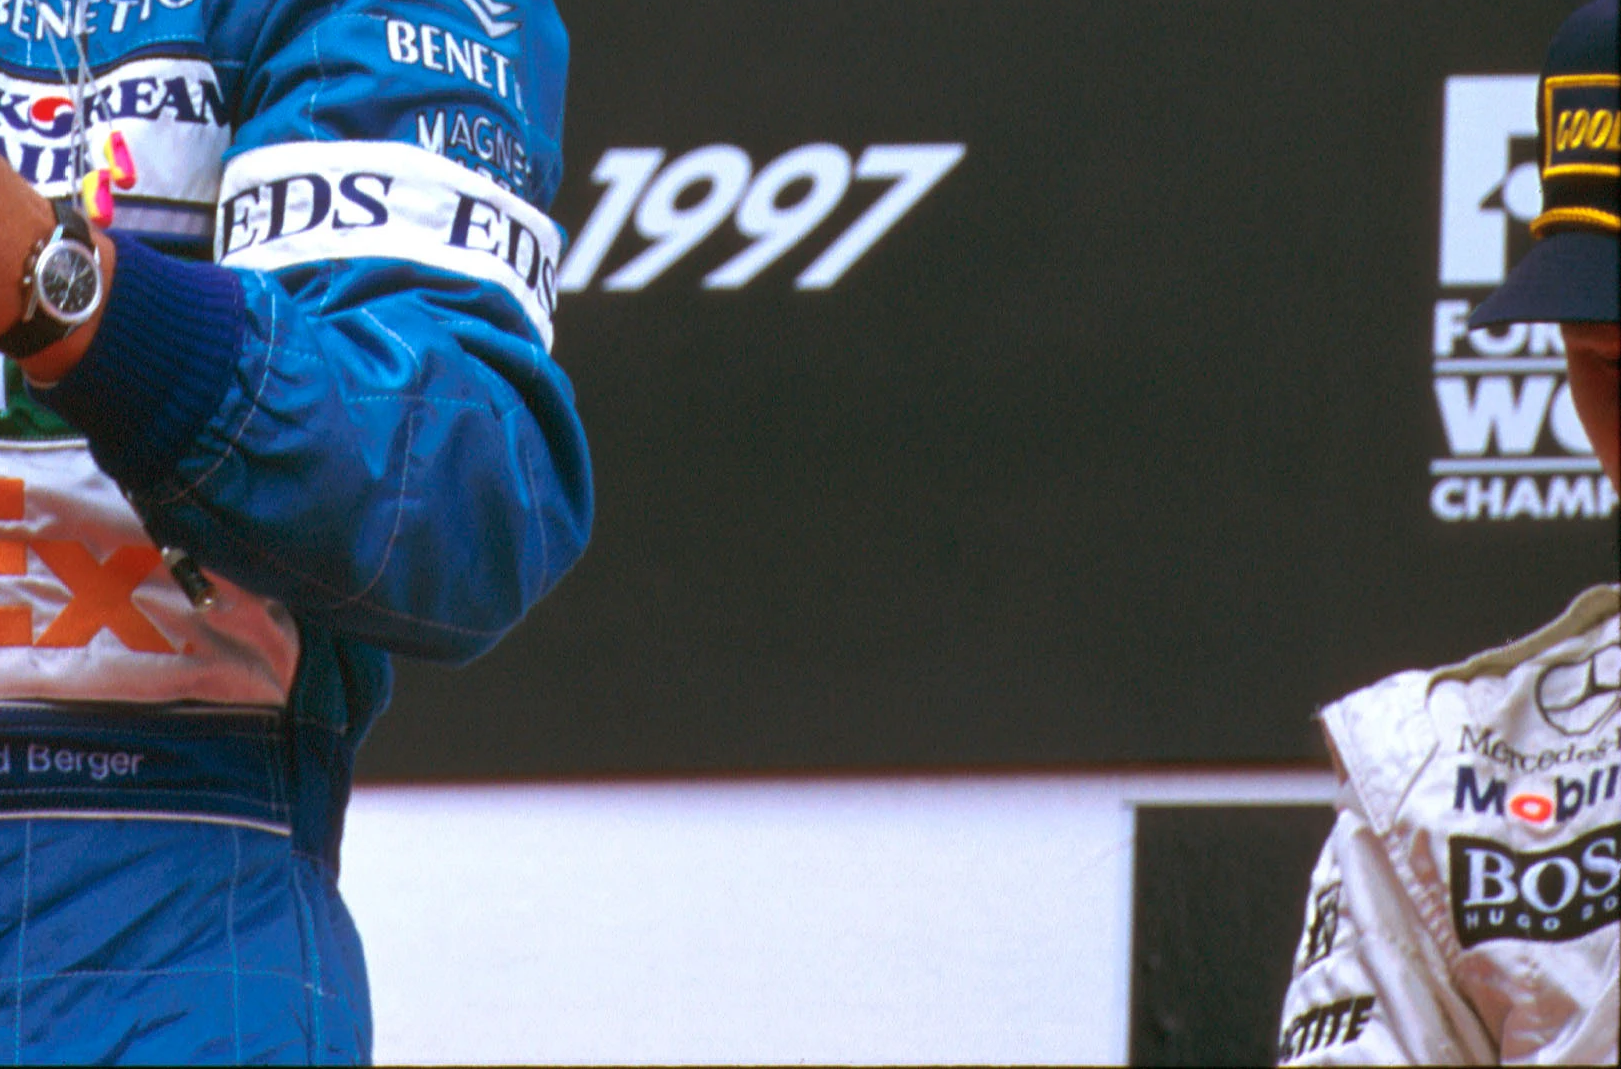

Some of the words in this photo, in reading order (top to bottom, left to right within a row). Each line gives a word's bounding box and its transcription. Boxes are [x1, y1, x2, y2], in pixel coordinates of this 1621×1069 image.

[222, 172, 394, 262] EDS
[554, 142, 968, 292] 1997
[28, 744, 144, 780] Berger
[1454, 764, 1620, 823] Mobil
[1464, 906, 1561, 933] HUGO
